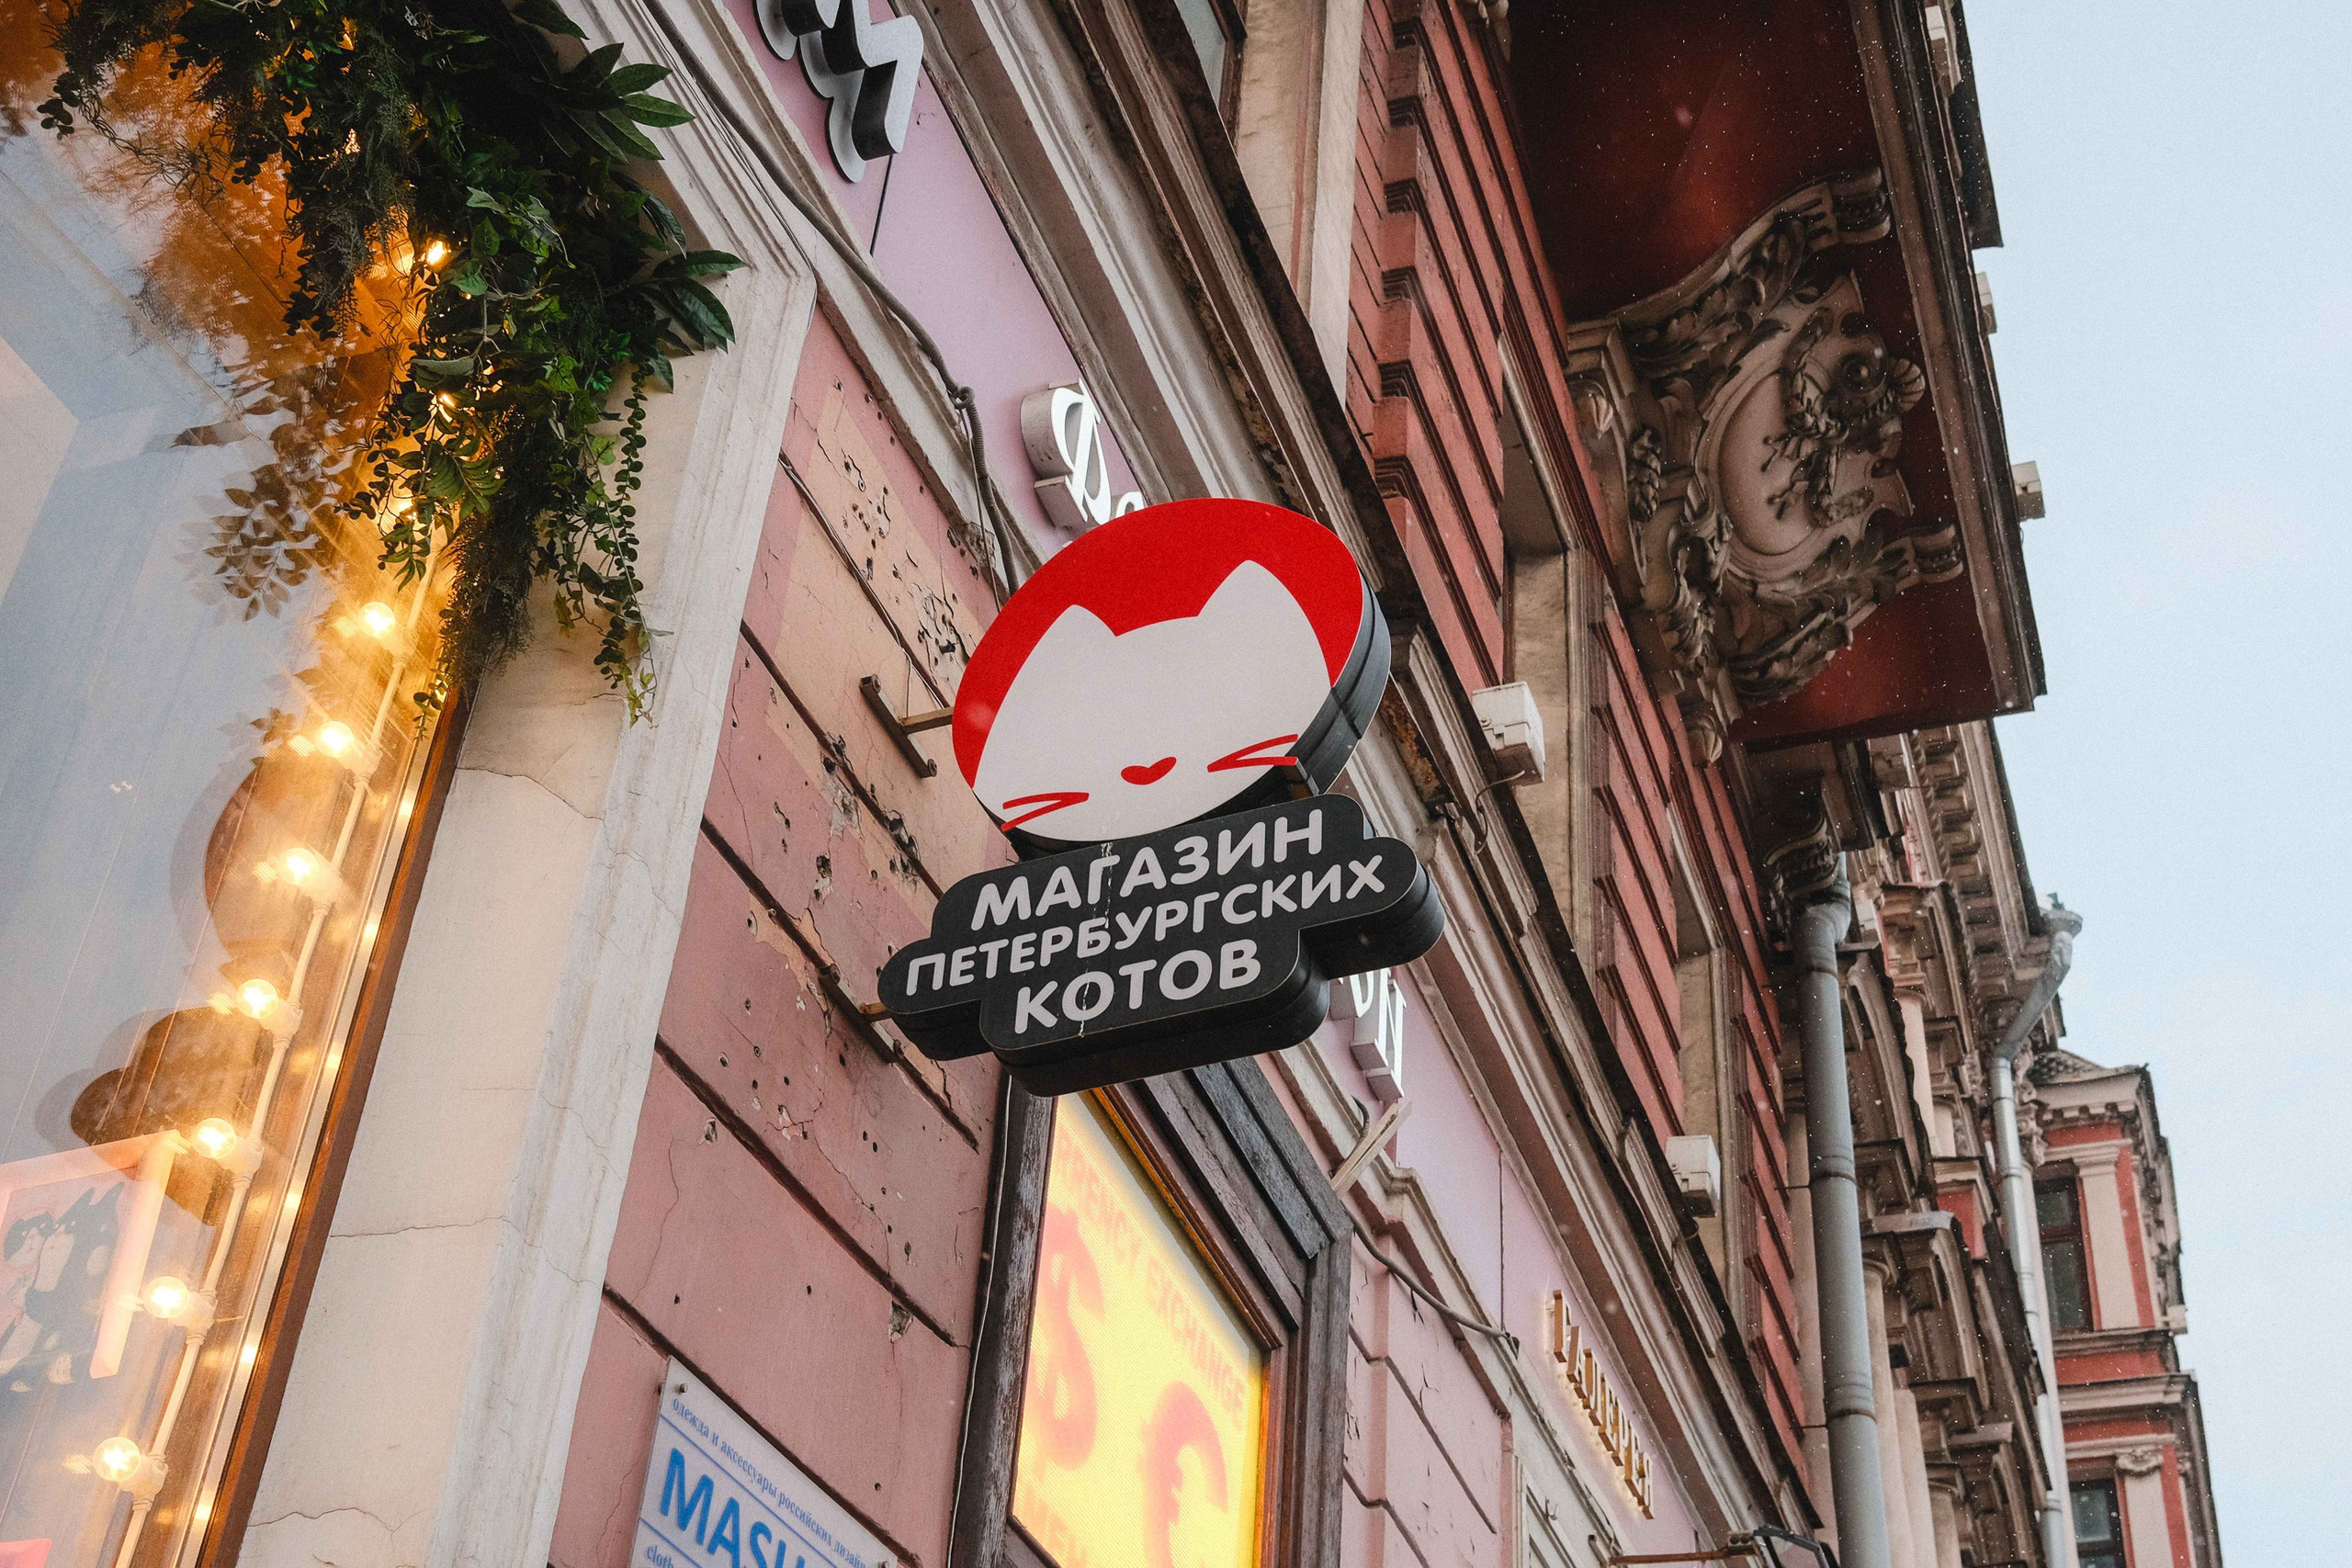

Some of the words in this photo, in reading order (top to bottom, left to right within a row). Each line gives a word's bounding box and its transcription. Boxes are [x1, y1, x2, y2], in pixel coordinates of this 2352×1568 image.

[906, 855, 1385, 996] ПЕТЕРБУРГСКИХ
[970, 809, 1323, 931] МАГАЗИН
[1013, 938, 1261, 1034] КОТОВ
[1145, 1252, 1247, 1433] EXCHANGE
[1554, 1290, 1654, 1518] ГАЛЕРЕЯ
[673, 1398, 709, 1438] одежда
[711, 1432, 719, 1448] и
[720, 1440, 777, 1498] аксессуары
[778, 1492, 832, 1547] российских
